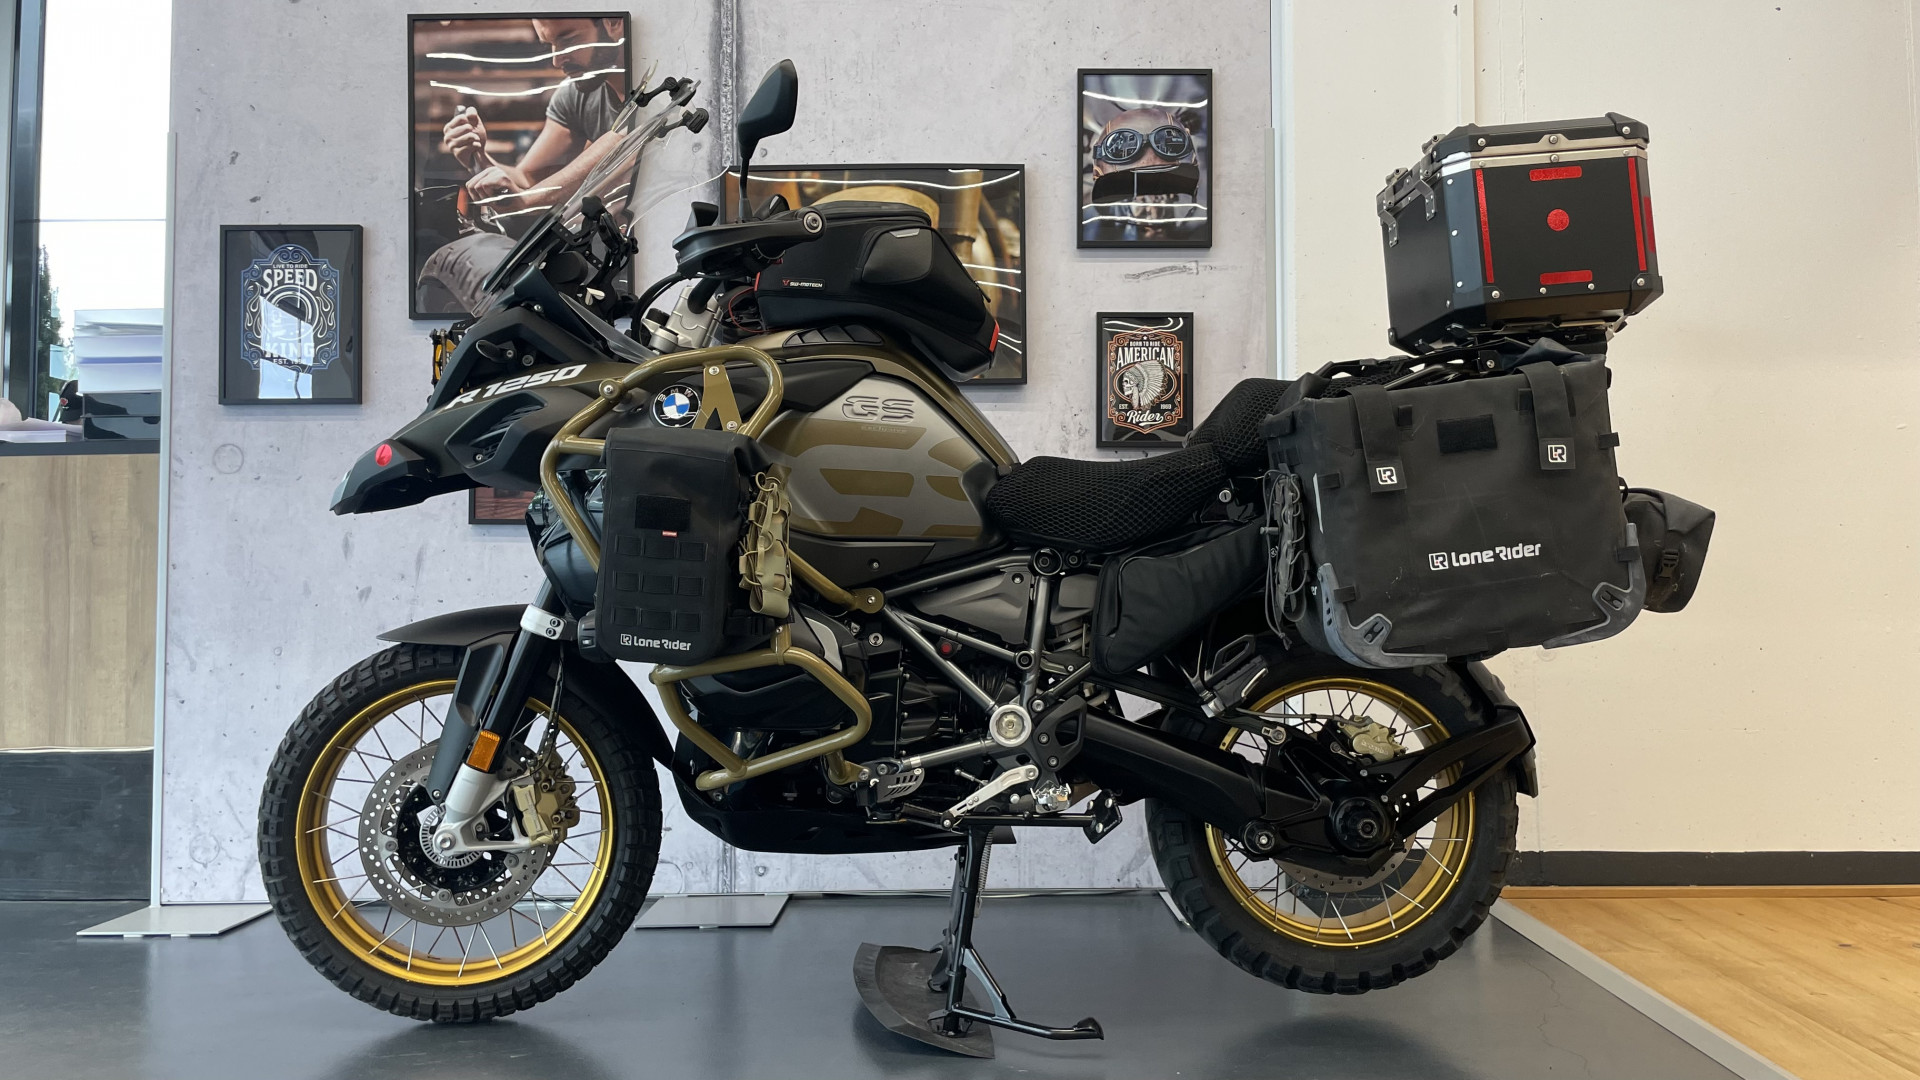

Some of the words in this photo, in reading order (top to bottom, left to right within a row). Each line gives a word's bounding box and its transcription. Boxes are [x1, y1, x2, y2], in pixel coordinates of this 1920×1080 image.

[262, 268, 318, 294] SPEED
[264, 342, 315, 358] KING
[1115, 347, 1175, 370] AMERICAN
[444, 388, 482, 410] R
[482, 363, 588, 398] 1250
[657, 387, 694, 403] BMW
[842, 395, 915, 424] GS
[1126, 409, 1164, 426] Rider
[1450, 550, 1495, 567] Lone
[1495, 543, 1542, 561] Rider
[633, 635, 661, 648] Lone
[661, 638, 692, 651] Rider
